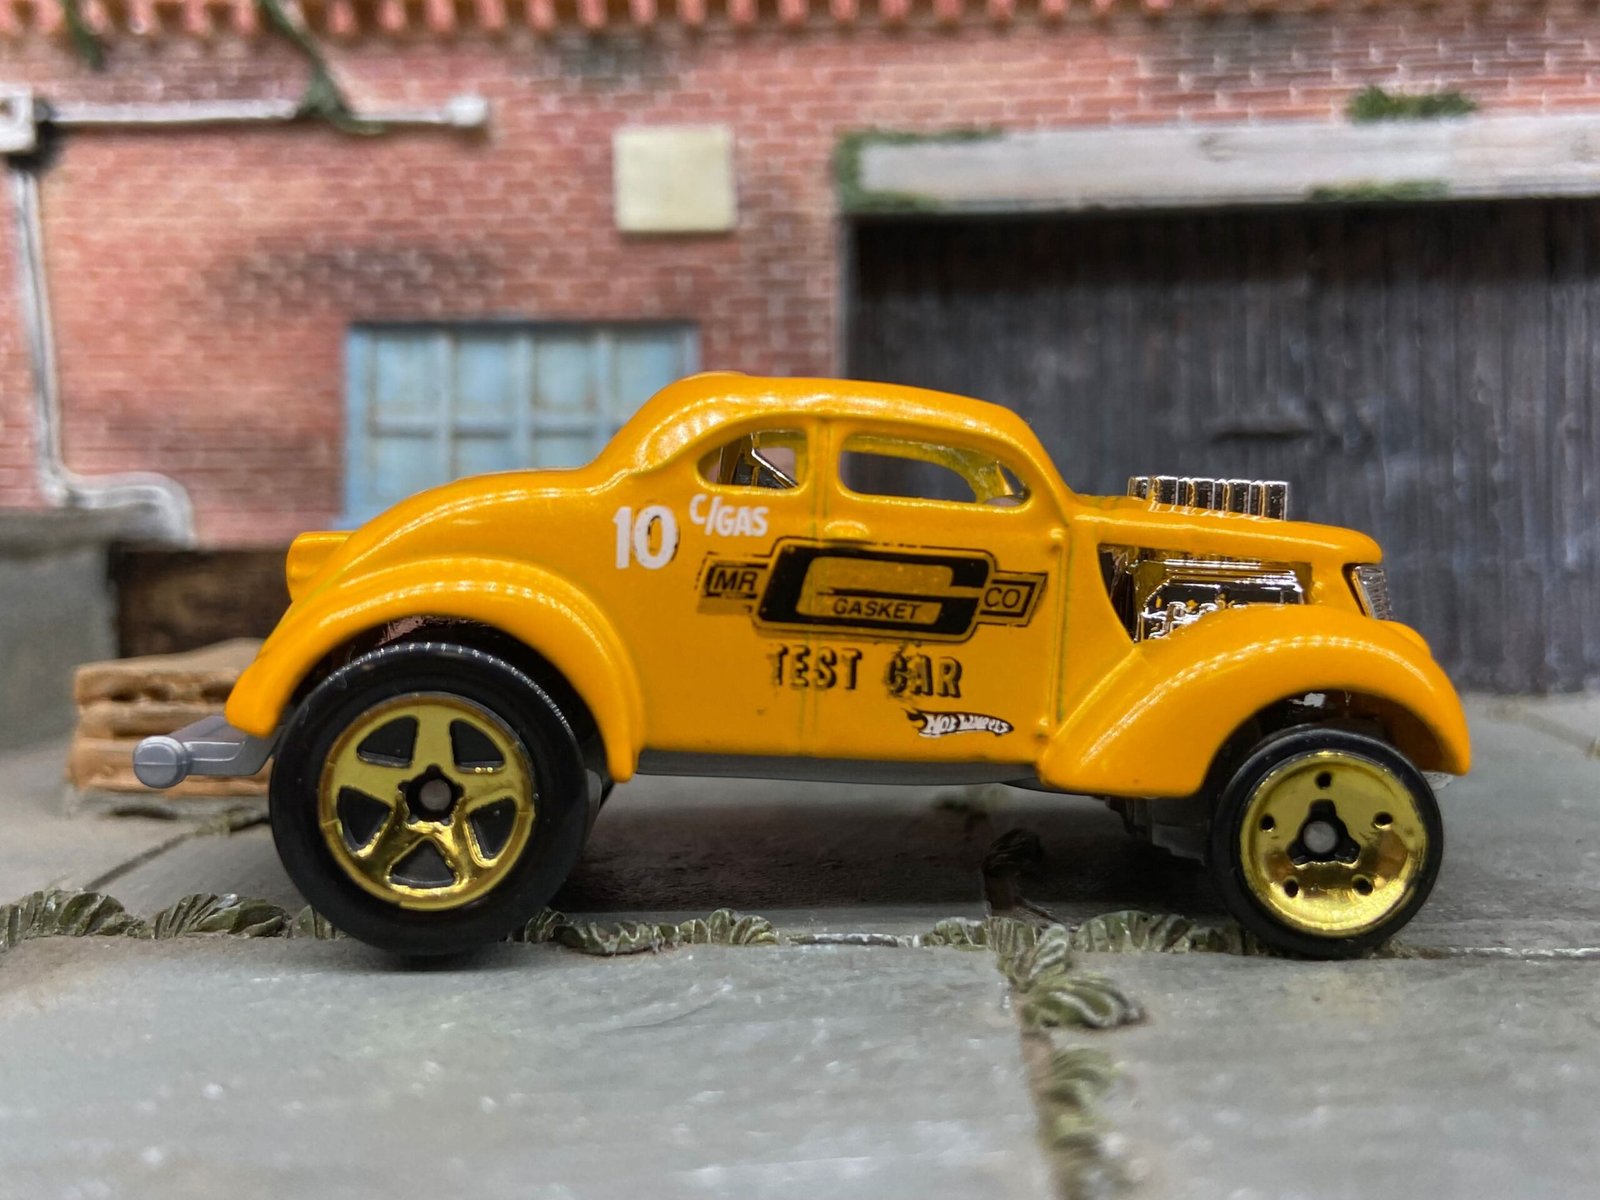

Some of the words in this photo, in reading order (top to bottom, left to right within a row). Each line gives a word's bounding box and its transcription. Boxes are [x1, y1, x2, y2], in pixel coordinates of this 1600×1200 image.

[613, 505, 679, 569] 10
[690, 494, 768, 536] C/GAS
[713, 570, 757, 592] MR
[832, 598, 921, 621] GASKET
[984, 584, 1021, 609] CO
[772, 646, 862, 690] TEST
[885, 650, 962, 698] CAR
